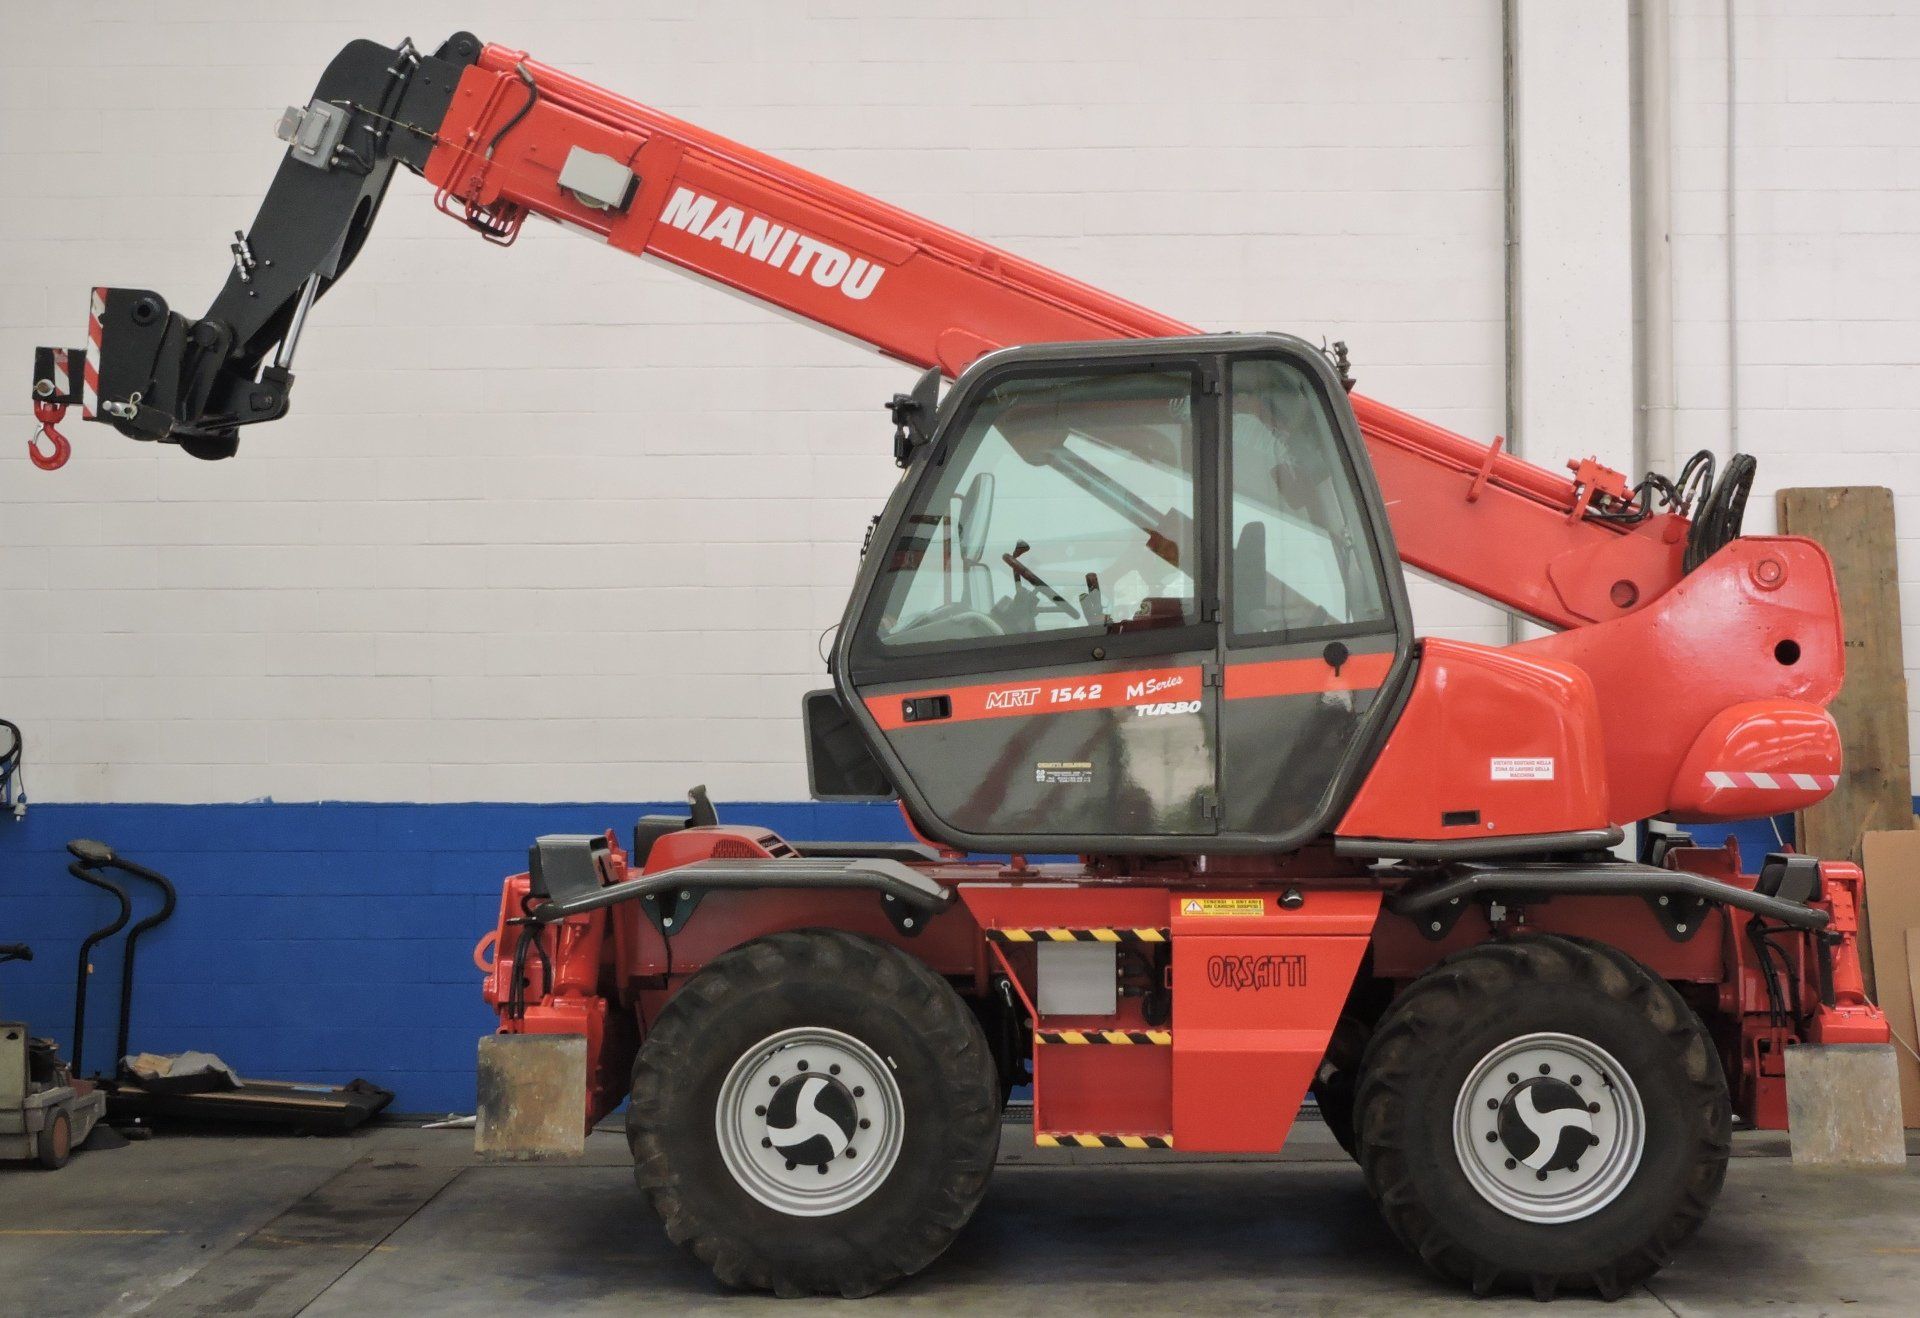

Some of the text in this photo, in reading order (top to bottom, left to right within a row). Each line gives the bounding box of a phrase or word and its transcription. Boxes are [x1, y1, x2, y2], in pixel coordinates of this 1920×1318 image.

[659, 186, 886, 300] MANITOU
[986, 685, 1103, 709] MRT 1542
[1126, 675, 1184, 700] M Series
[1135, 700, 1202, 717] TURBO
[1207, 955, 1307, 991] ORSATTI
